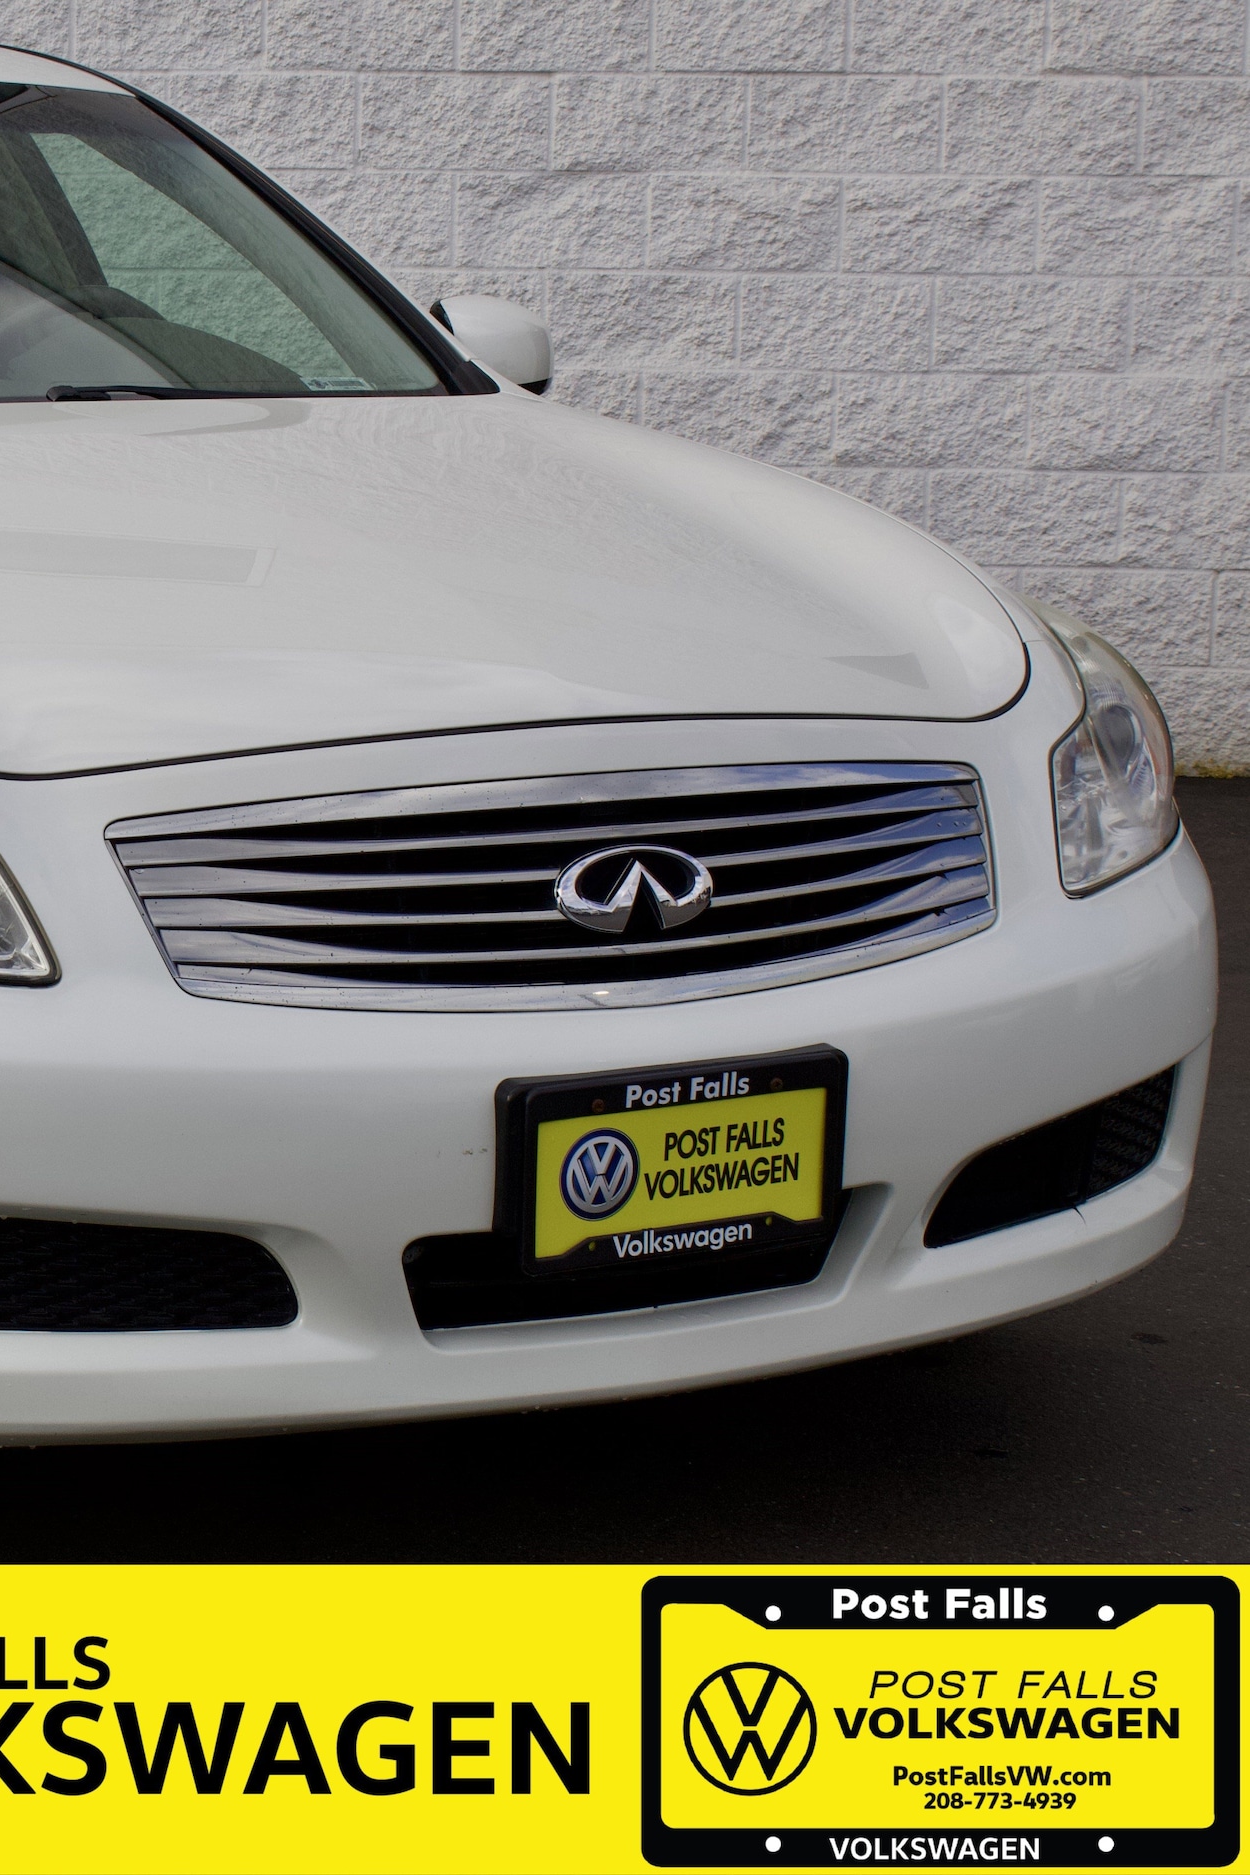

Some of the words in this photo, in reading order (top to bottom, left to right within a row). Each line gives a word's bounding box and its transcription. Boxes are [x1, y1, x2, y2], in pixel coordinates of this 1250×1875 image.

[625, 1084, 680, 1109] Post
[690, 1071, 750, 1101] Falls
[664, 1127, 721, 1161] POST
[726, 1117, 785, 1152] FALLS
[644, 1152, 800, 1201] VOLKSWAGEN
[612, 1222, 753, 1259] Volkswagen
